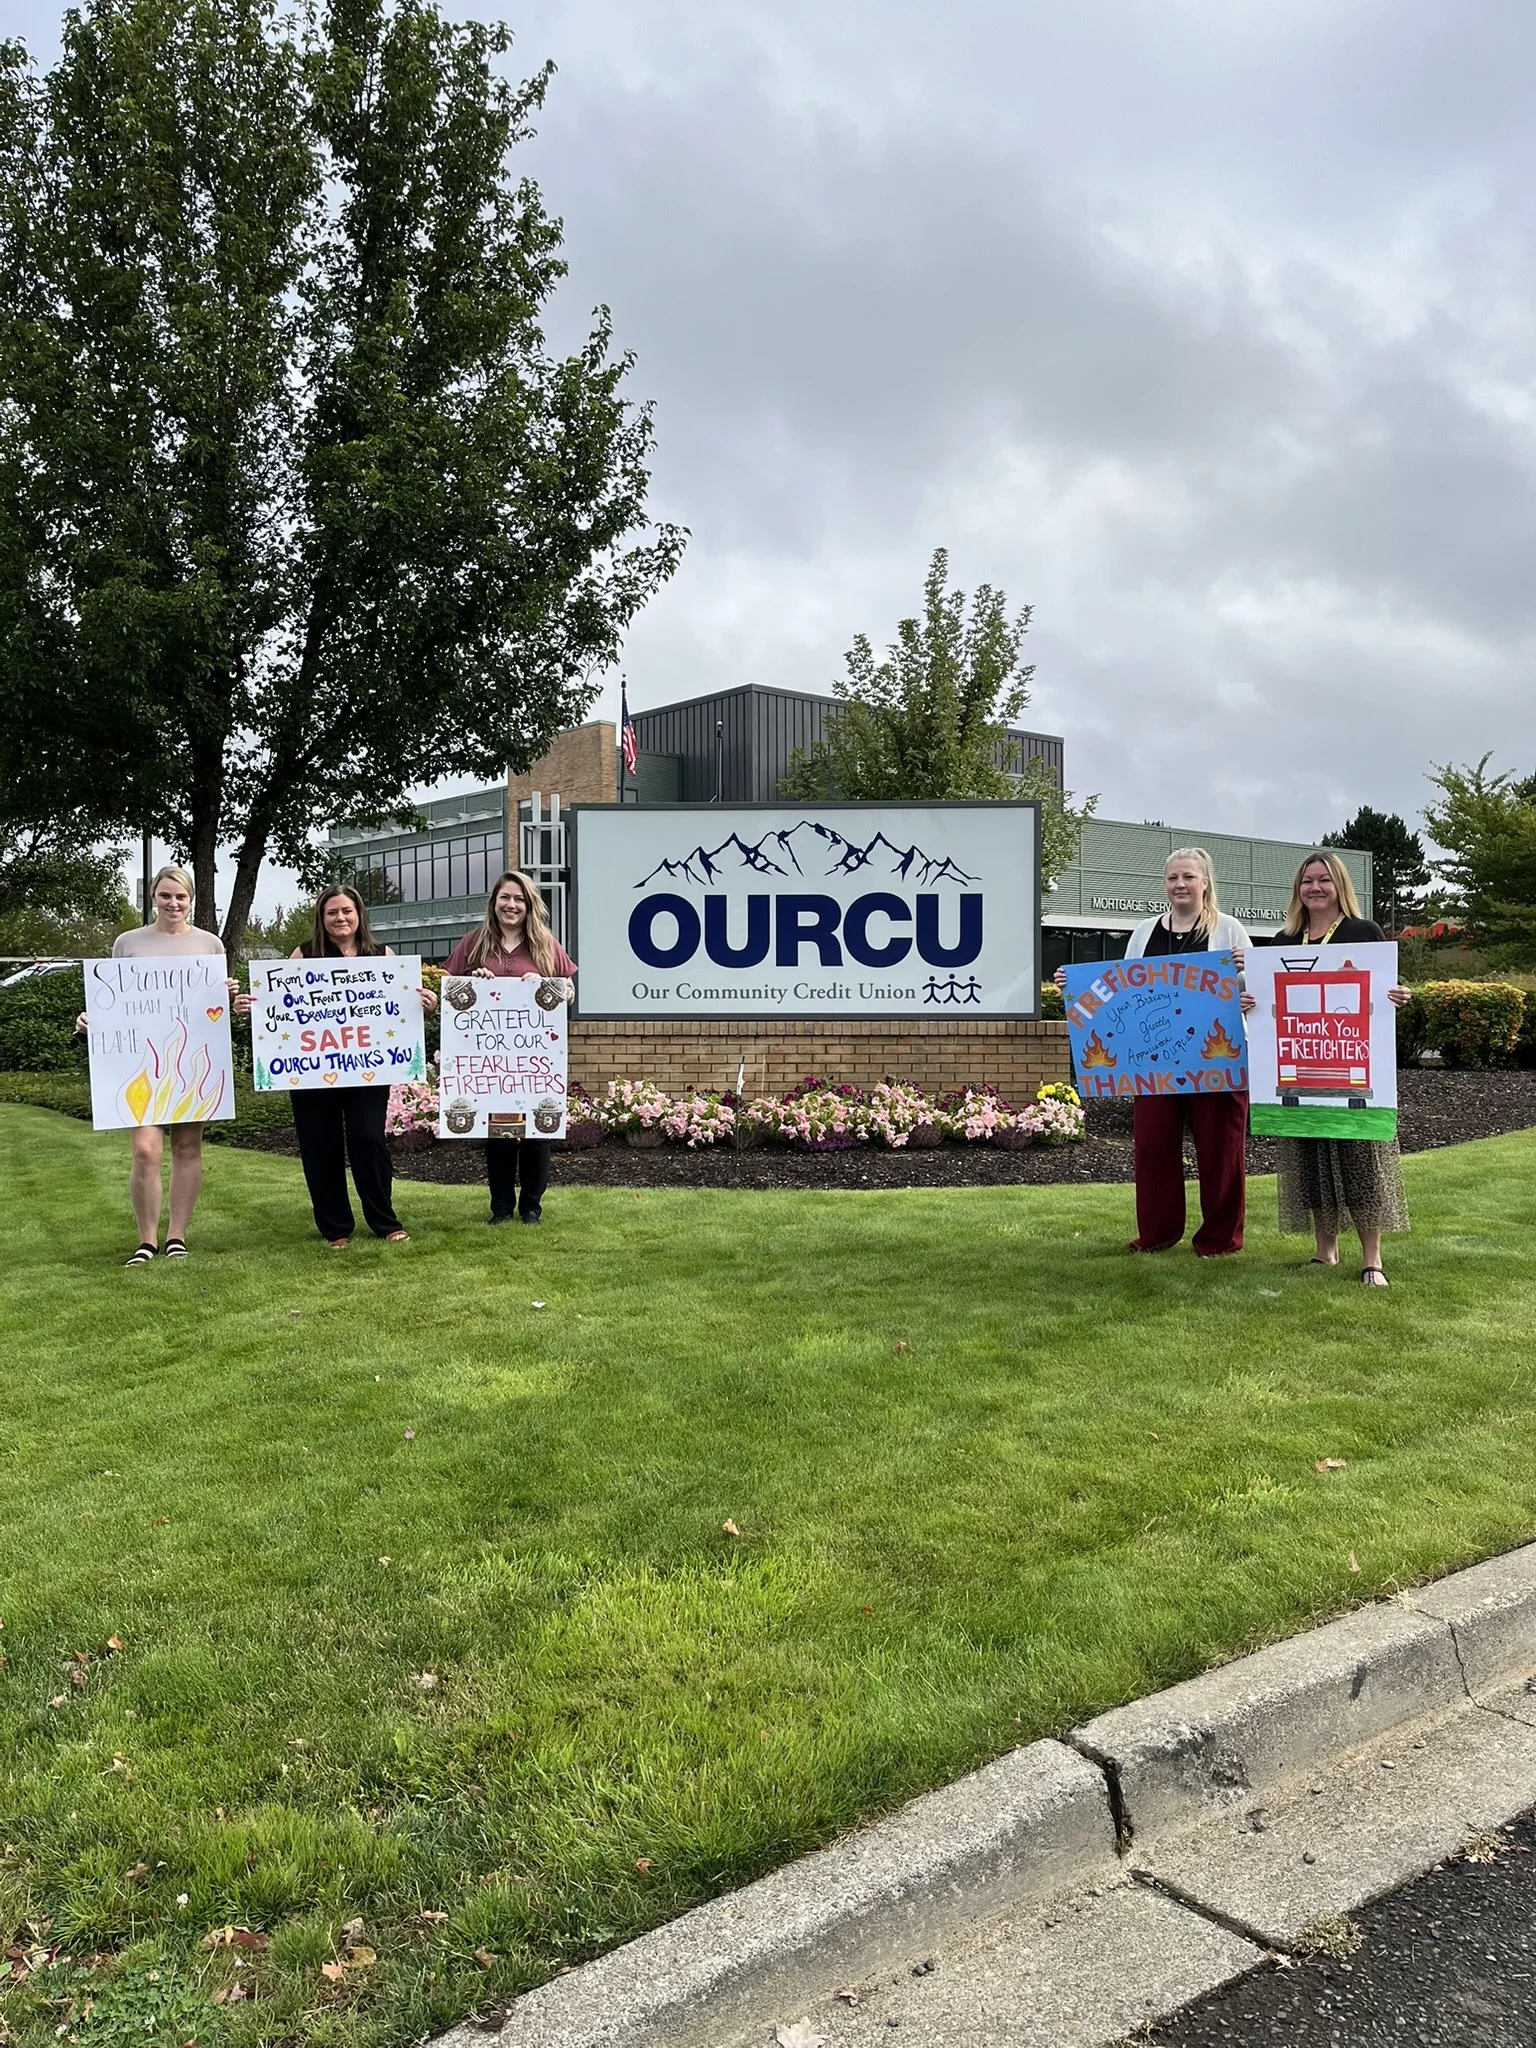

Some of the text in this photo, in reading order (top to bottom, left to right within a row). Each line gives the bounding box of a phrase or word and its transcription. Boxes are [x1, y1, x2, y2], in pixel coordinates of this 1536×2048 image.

[1092, 896, 1172, 912] MORTGAGE SERV
[1233, 907, 1281, 920] INVESTMENT
[628, 892, 983, 969] OURCU
[93, 958, 218, 1009] Stronger
[382, 971, 394, 984] to
[632, 982, 917, 1004] Our Community Credit Union
[1066, 961, 1239, 1029] FIREFIGHTERS
[122, 999, 190, 1024] THAN THE
[350, 1004, 382, 1018] KEEPS
[453, 1009, 555, 1031] GRATEFUL
[1105, 1001, 1133, 1035] Your
[300, 1025, 372, 1052] SAFE
[1282, 1016, 1360, 1038] Thank You
[91, 1027, 140, 1055] FLAME
[476, 1033, 548, 1051] FOR OUR
[1278, 1037, 1370, 1061] FIREFIGHTERS
[269, 1047, 413, 1075] OURCU THANKS YOU
[455, 1055, 551, 1075] FEARLESS
[443, 1074, 565, 1096] FIREFIGHTERS
[1078, 1066, 1248, 1098] THANK YOU
